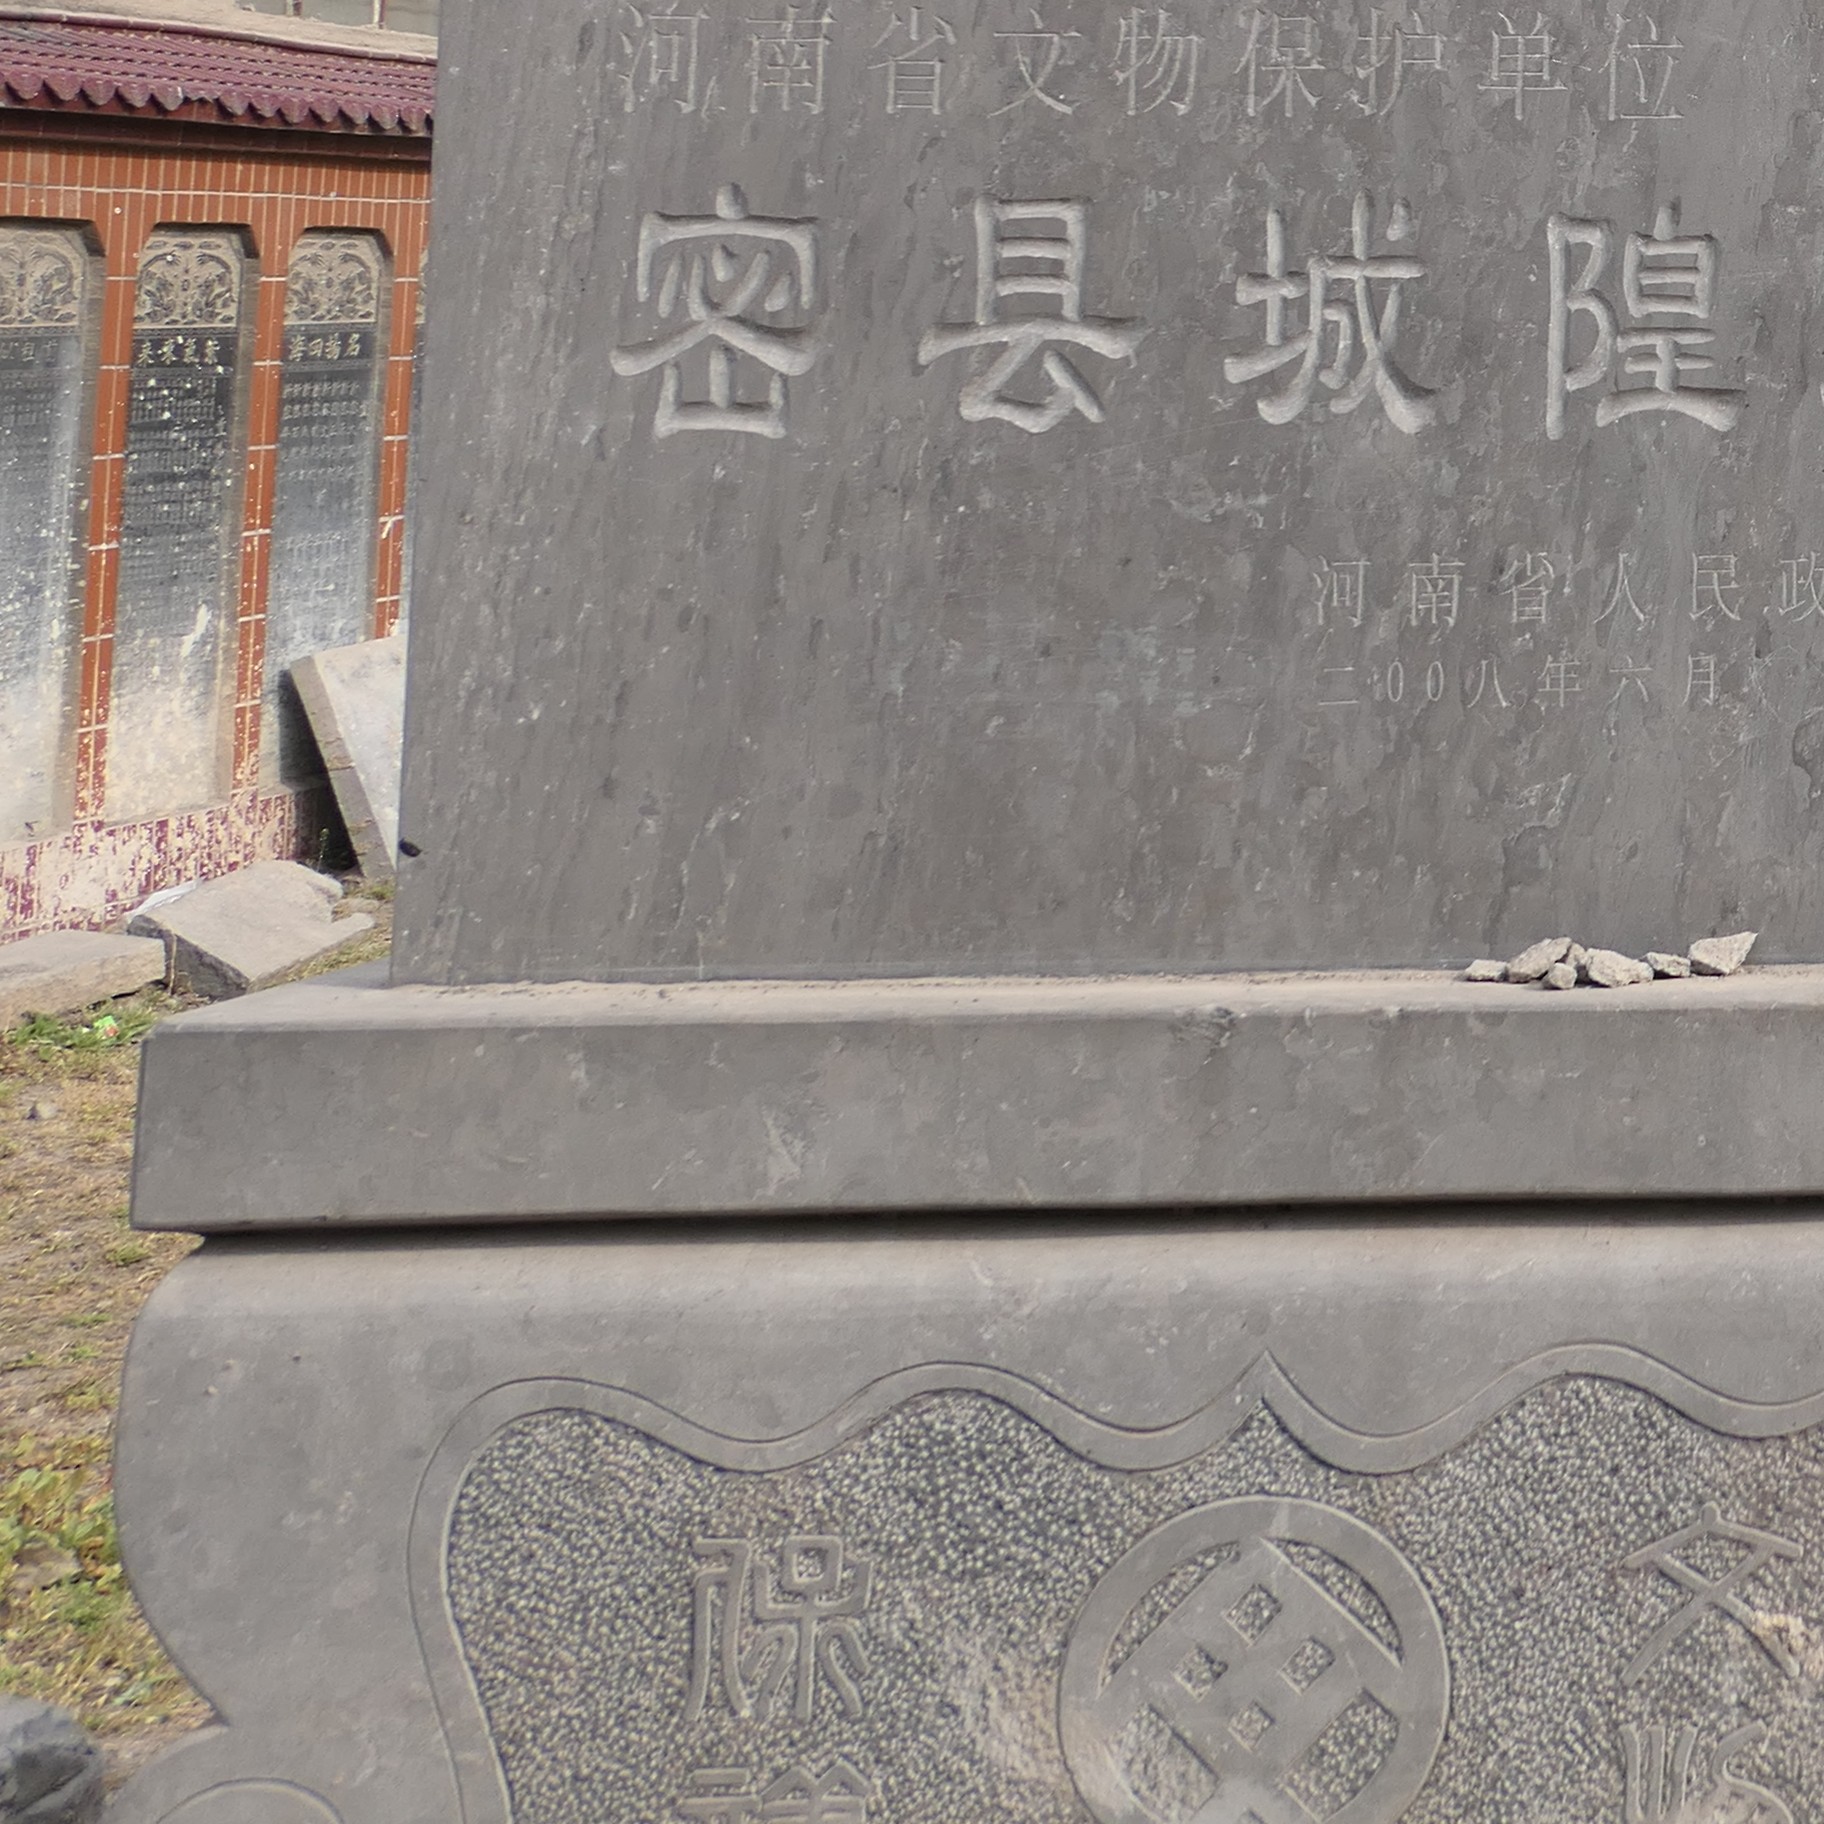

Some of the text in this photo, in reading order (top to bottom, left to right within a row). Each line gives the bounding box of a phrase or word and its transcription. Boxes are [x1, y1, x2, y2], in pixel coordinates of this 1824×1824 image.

[622, 2, 1685, 122] 河南省文物保护单位
